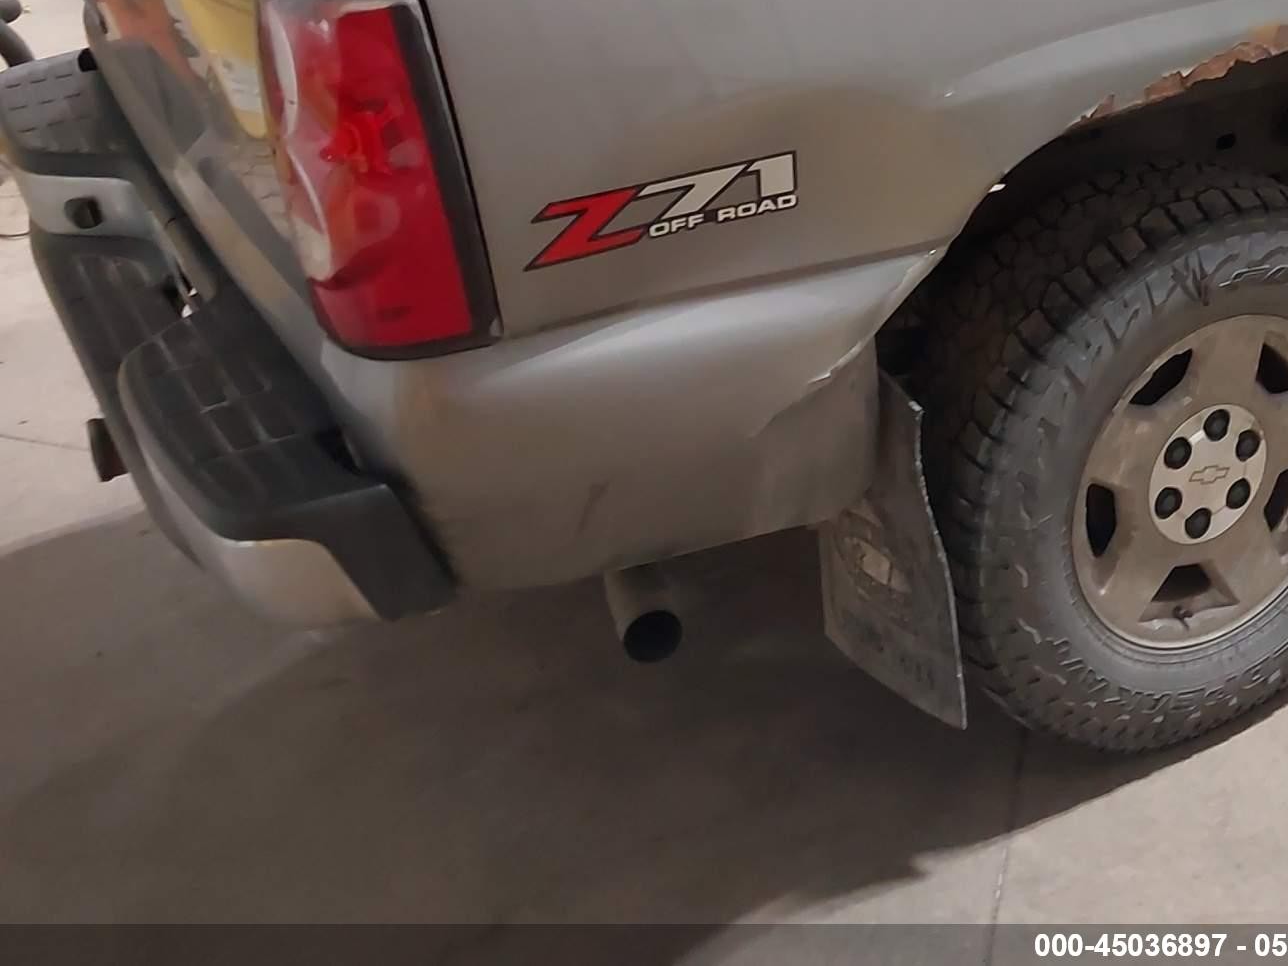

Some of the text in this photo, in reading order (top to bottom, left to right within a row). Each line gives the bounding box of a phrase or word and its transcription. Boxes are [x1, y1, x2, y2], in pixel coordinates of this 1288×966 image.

[523, 149, 797, 273] Z71
[648, 193, 798, 239] OFF ROAD
